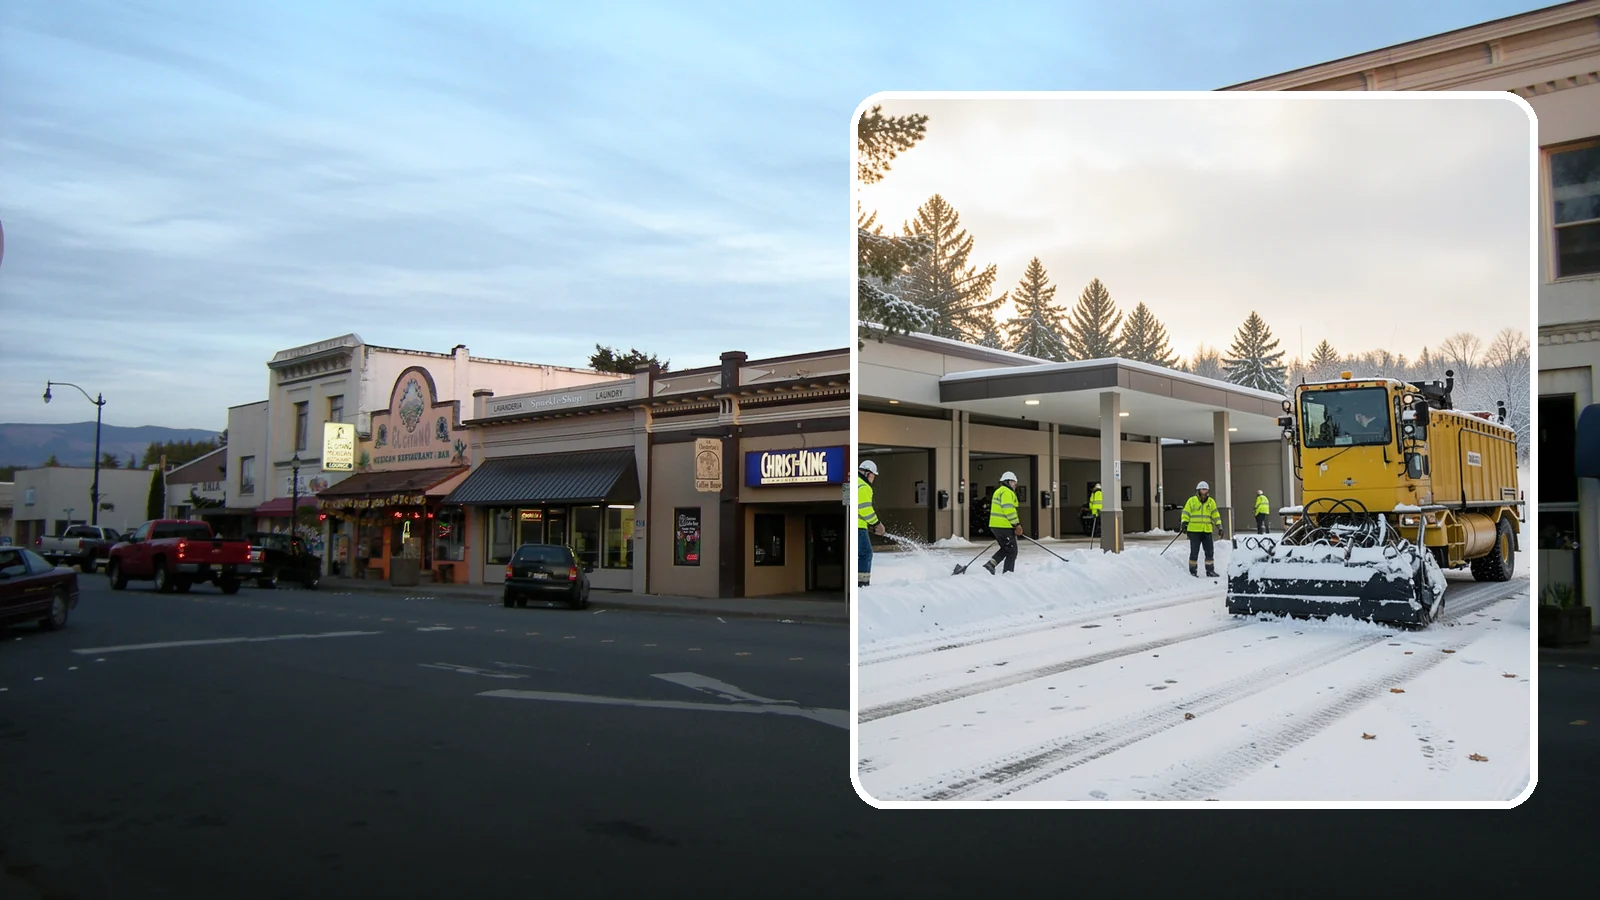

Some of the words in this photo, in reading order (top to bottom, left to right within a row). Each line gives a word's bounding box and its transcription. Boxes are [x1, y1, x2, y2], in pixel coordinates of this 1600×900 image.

[530, 395, 562, 409] Sparkle
[562, 394, 583, 408] Shop
[595, 389, 624, 400] LAUNDRY
[493, 401, 523, 412] LAVANDERIA
[373, 455, 396, 464] MEXICAN
[397, 451, 434, 463] RESTAURANT
[437, 450, 450, 459] BAR
[761, 452, 797, 478] CHRIST
[799, 450, 827, 476] KING
